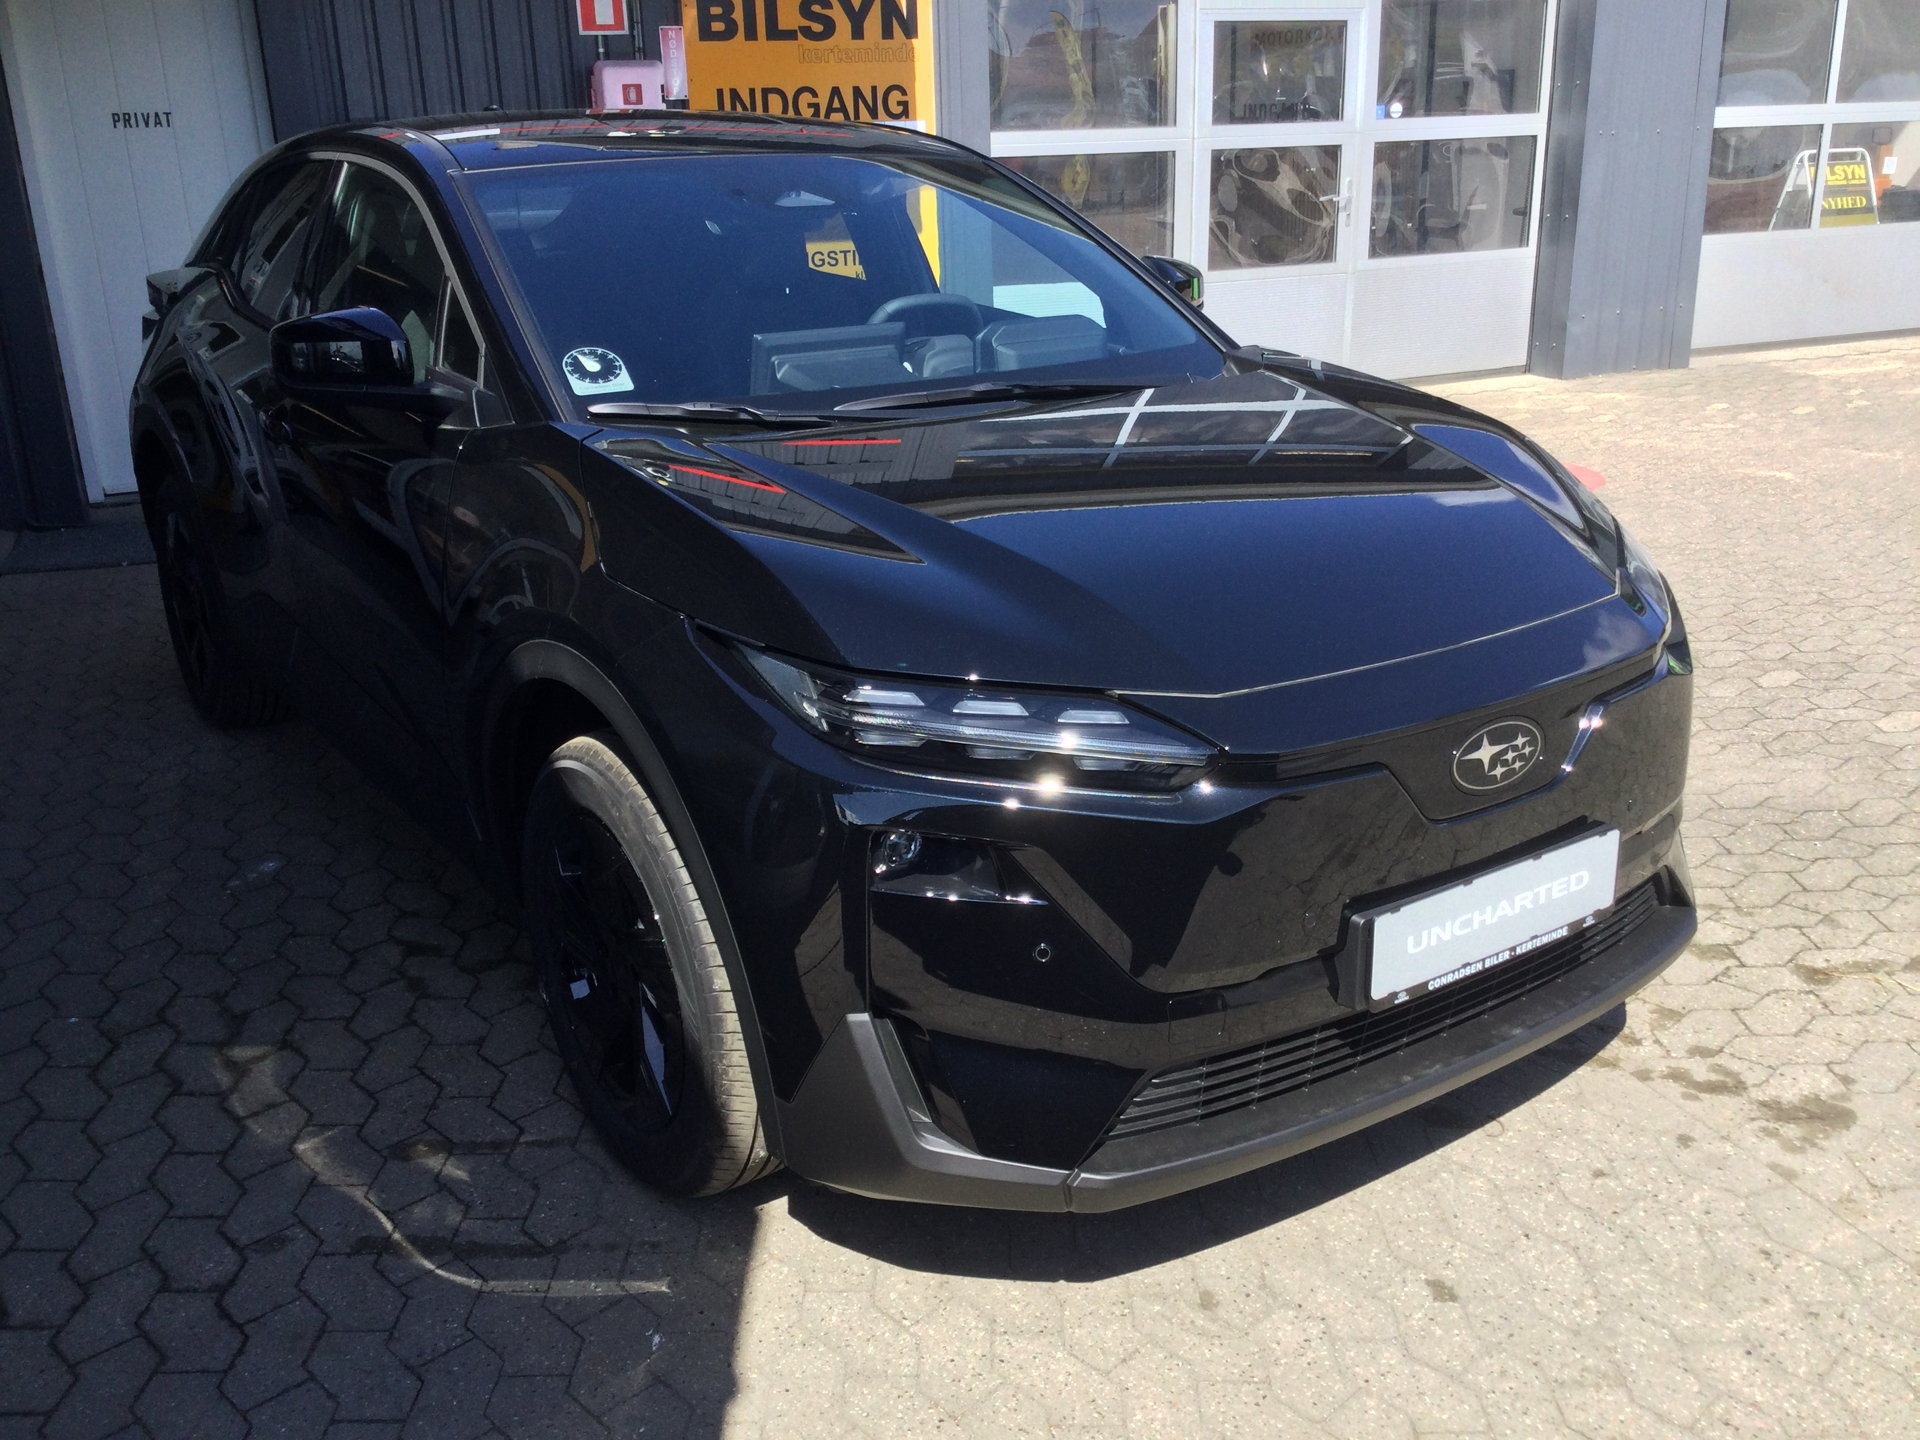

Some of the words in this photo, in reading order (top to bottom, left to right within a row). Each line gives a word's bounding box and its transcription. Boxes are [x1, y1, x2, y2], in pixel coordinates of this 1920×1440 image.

[696, 0, 918, 42] BILSYN
[667, 30, 680, 96] NØDSTOP
[798, 42, 921, 64] kerteminde
[111, 112, 172, 129] PRIVAT
[716, 84, 910, 121] INDGANG
[1407, 870, 1589, 954] UNCHARTED
[1427, 960, 1483, 991] CONRADSEN
[1484, 949, 1511, 969] BILER
[1515, 926, 1569, 955] KERTEMINDE
